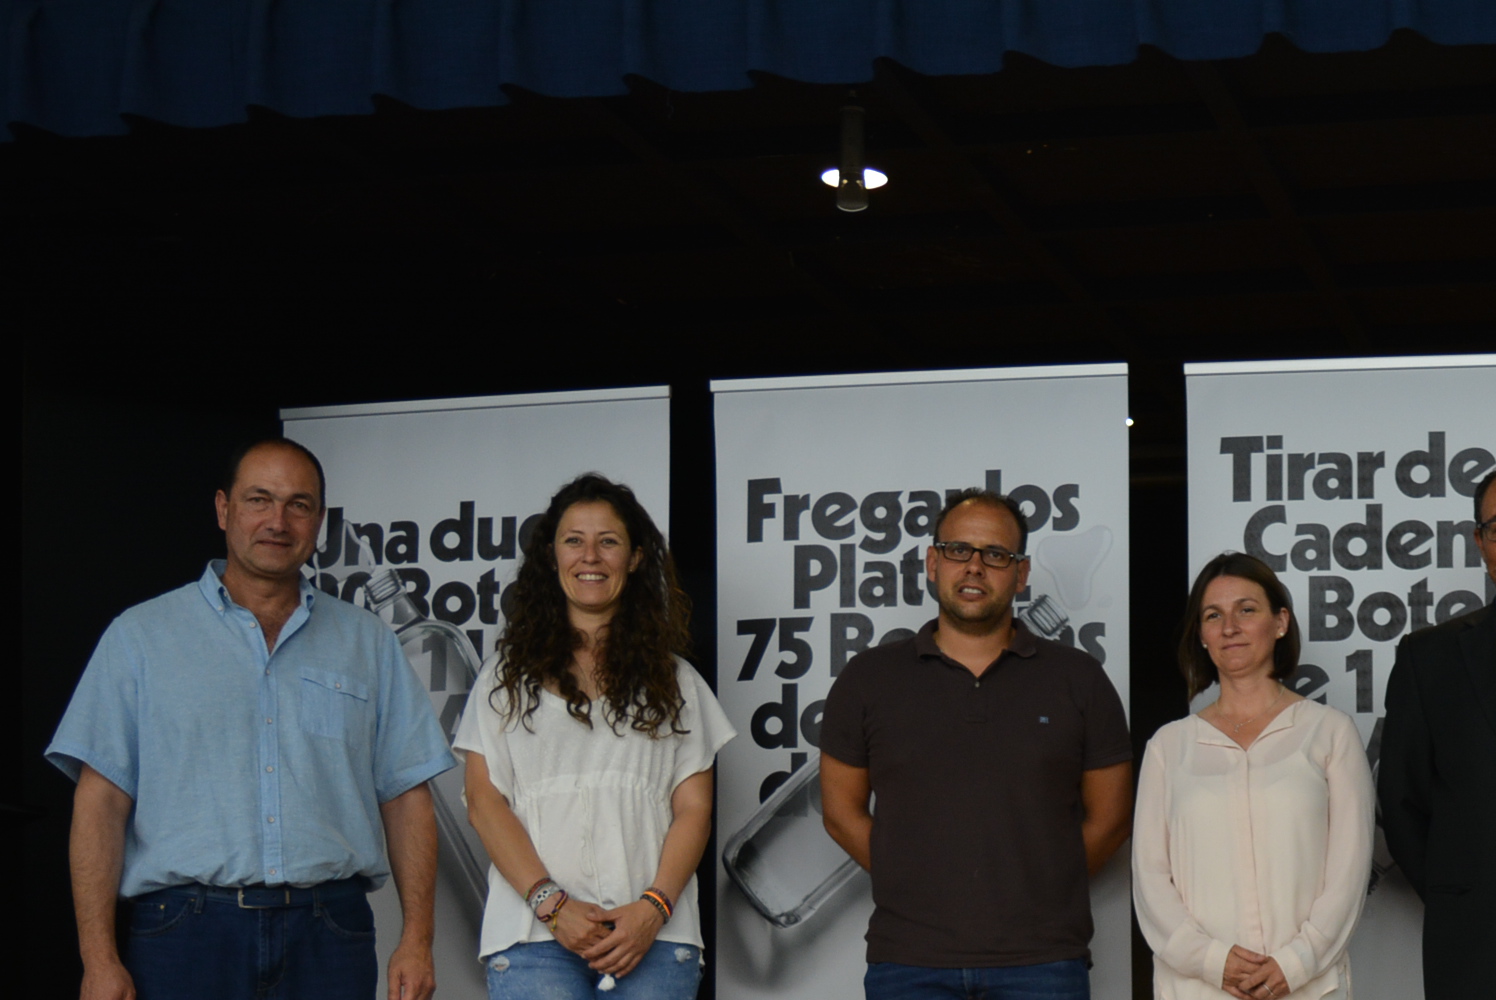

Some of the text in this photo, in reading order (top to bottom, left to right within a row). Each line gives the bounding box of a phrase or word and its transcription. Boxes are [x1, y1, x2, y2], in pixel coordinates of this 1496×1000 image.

[1220, 435, 1385, 502] Tirar
[1395, 431, 1496, 499] de
[1244, 504, 1481, 572] Caden
[737, 617, 813, 682] 75
[1345, 649, 1374, 713] 1
